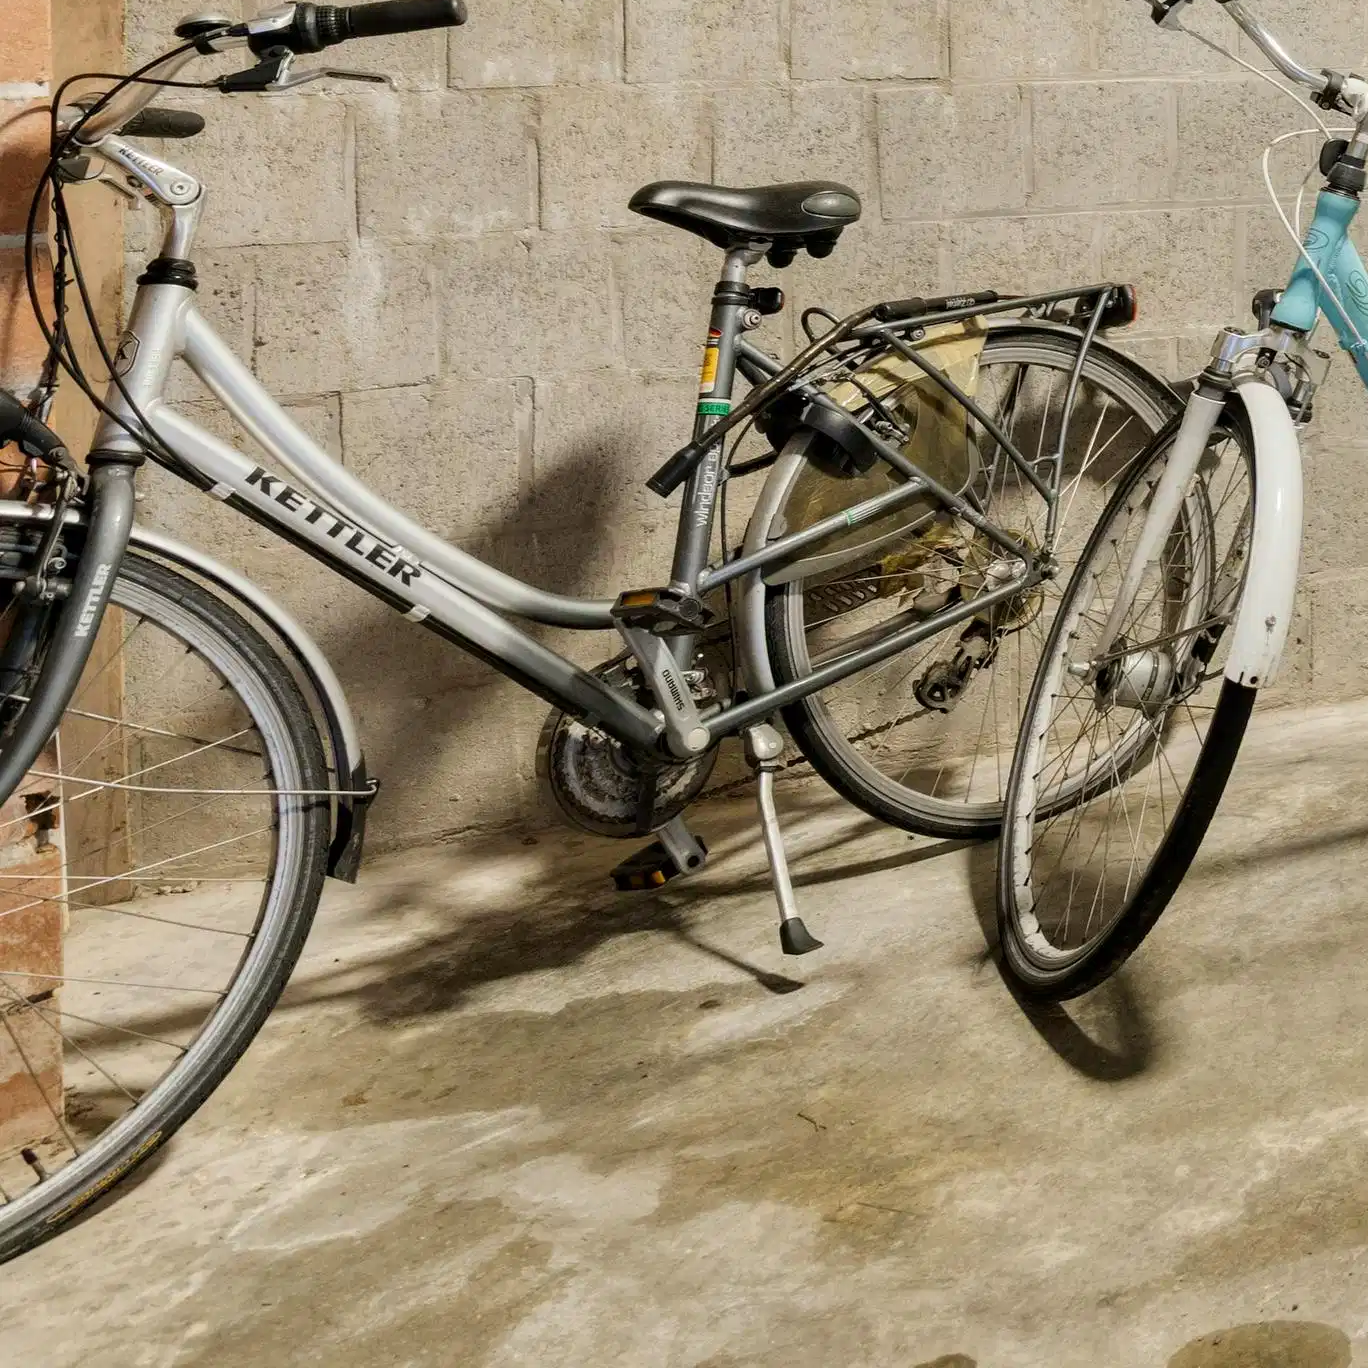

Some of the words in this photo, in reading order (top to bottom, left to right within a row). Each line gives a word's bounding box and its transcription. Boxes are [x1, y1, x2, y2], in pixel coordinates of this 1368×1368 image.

[244, 466, 423, 588] KETTLER
[74, 563, 112, 638] KETTLER
[662, 669, 686, 712] SHIMANO
